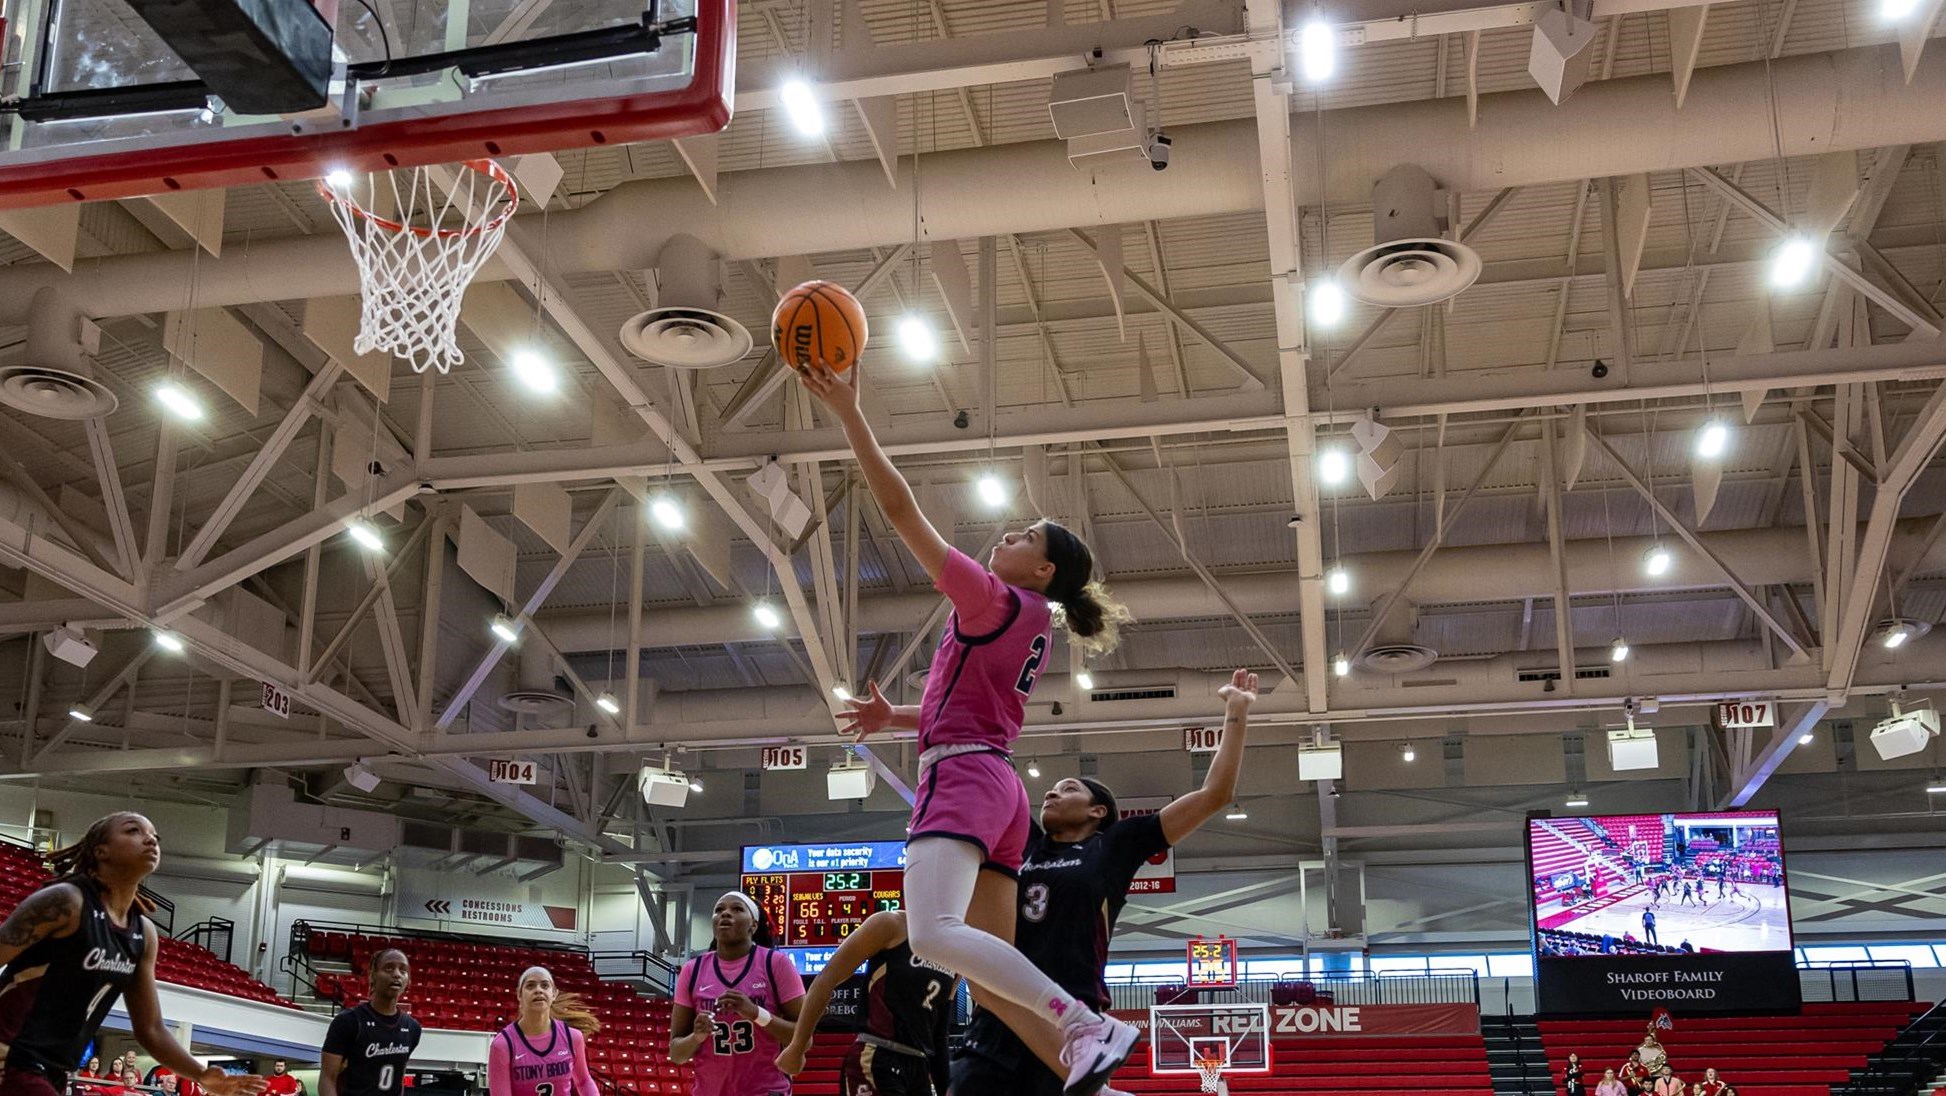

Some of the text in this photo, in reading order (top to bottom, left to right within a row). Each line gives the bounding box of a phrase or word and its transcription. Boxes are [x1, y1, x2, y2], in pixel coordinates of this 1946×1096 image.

[1014, 633, 1047, 696] 2
[266, 688, 289, 715] 203
[1731, 704, 1766, 724] 107
[1195, 729, 1224, 748] 10
[772, 748, 803, 767] 105
[501, 763, 533, 781] 104
[807, 846, 873, 858] Your data security
[808, 858, 815, 867] is
[816, 859, 830, 868] our
[840, 857, 869, 869] priority
[746, 875, 784, 885] PLY FL PTS
[826, 873, 860, 890] 25.2
[1129, 880, 1161, 891] 2012-16
[765, 885, 771, 895] 3
[873, 891, 901, 899] COUGARS
[462, 899, 522, 912] CONCESSIONS
[773, 894, 785, 904] 20
[1023, 883, 1049, 922] 3
[800, 902, 819, 918] 66
[843, 903, 852, 914] 4
[462, 910, 513, 923] RESTROOMS
[840, 924, 849, 937] 0
[805, 952, 823, 962] Your
[1193, 944, 1222, 958] 25.2
[1607, 970, 1724, 984] SHAROFF FAMILY
[922, 979, 941, 1011] 2
[1620, 988, 1716, 1001] VIDEOBOARD
[1212, 1007, 1362, 1034] RED ZONE
[713, 1020, 754, 1056] 23
[365, 1042, 410, 1058] Charleston
[378, 1064, 395, 1091] 0
[514, 1063, 544, 1081] STONY
